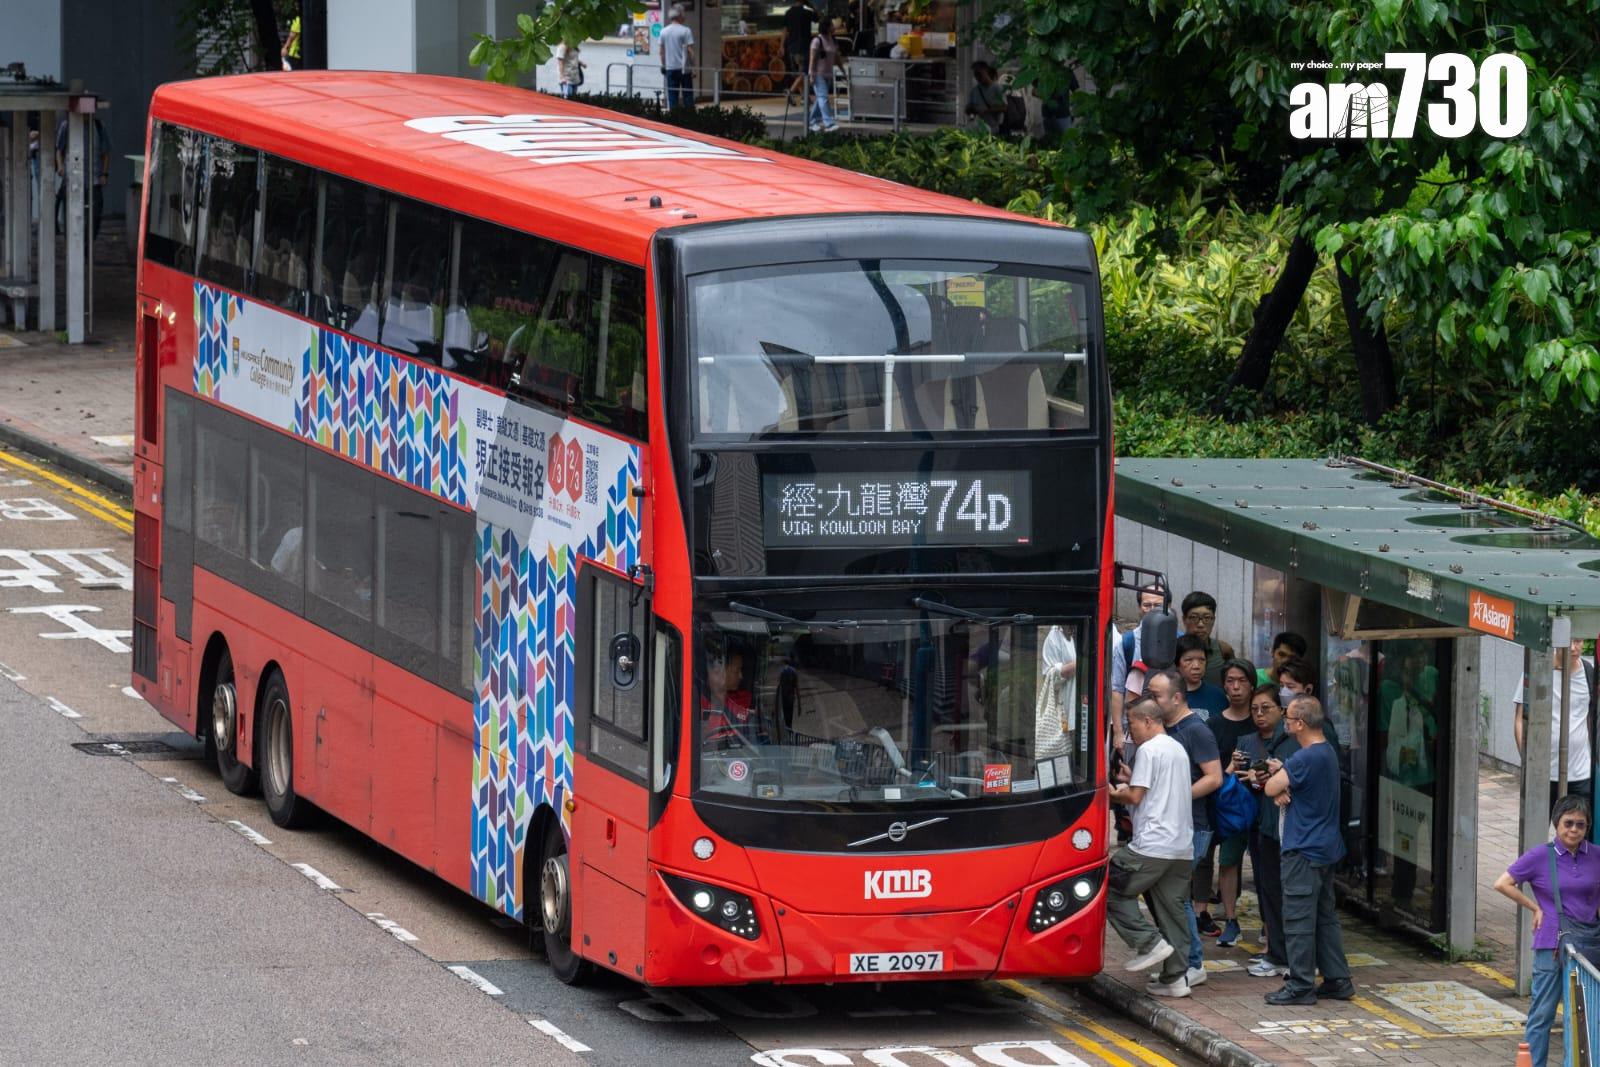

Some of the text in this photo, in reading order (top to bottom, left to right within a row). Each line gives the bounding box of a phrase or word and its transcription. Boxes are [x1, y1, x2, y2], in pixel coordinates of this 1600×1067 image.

[475, 438, 544, 501] 現正接受報名
[930, 479, 1012, 532] 74D
[782, 520, 921, 536] VIA: KOWLOON BAY
[1482, 604, 1511, 635] Asiaray
[864, 869, 932, 900] KMB
[854, 953, 940, 973] XE 2097
